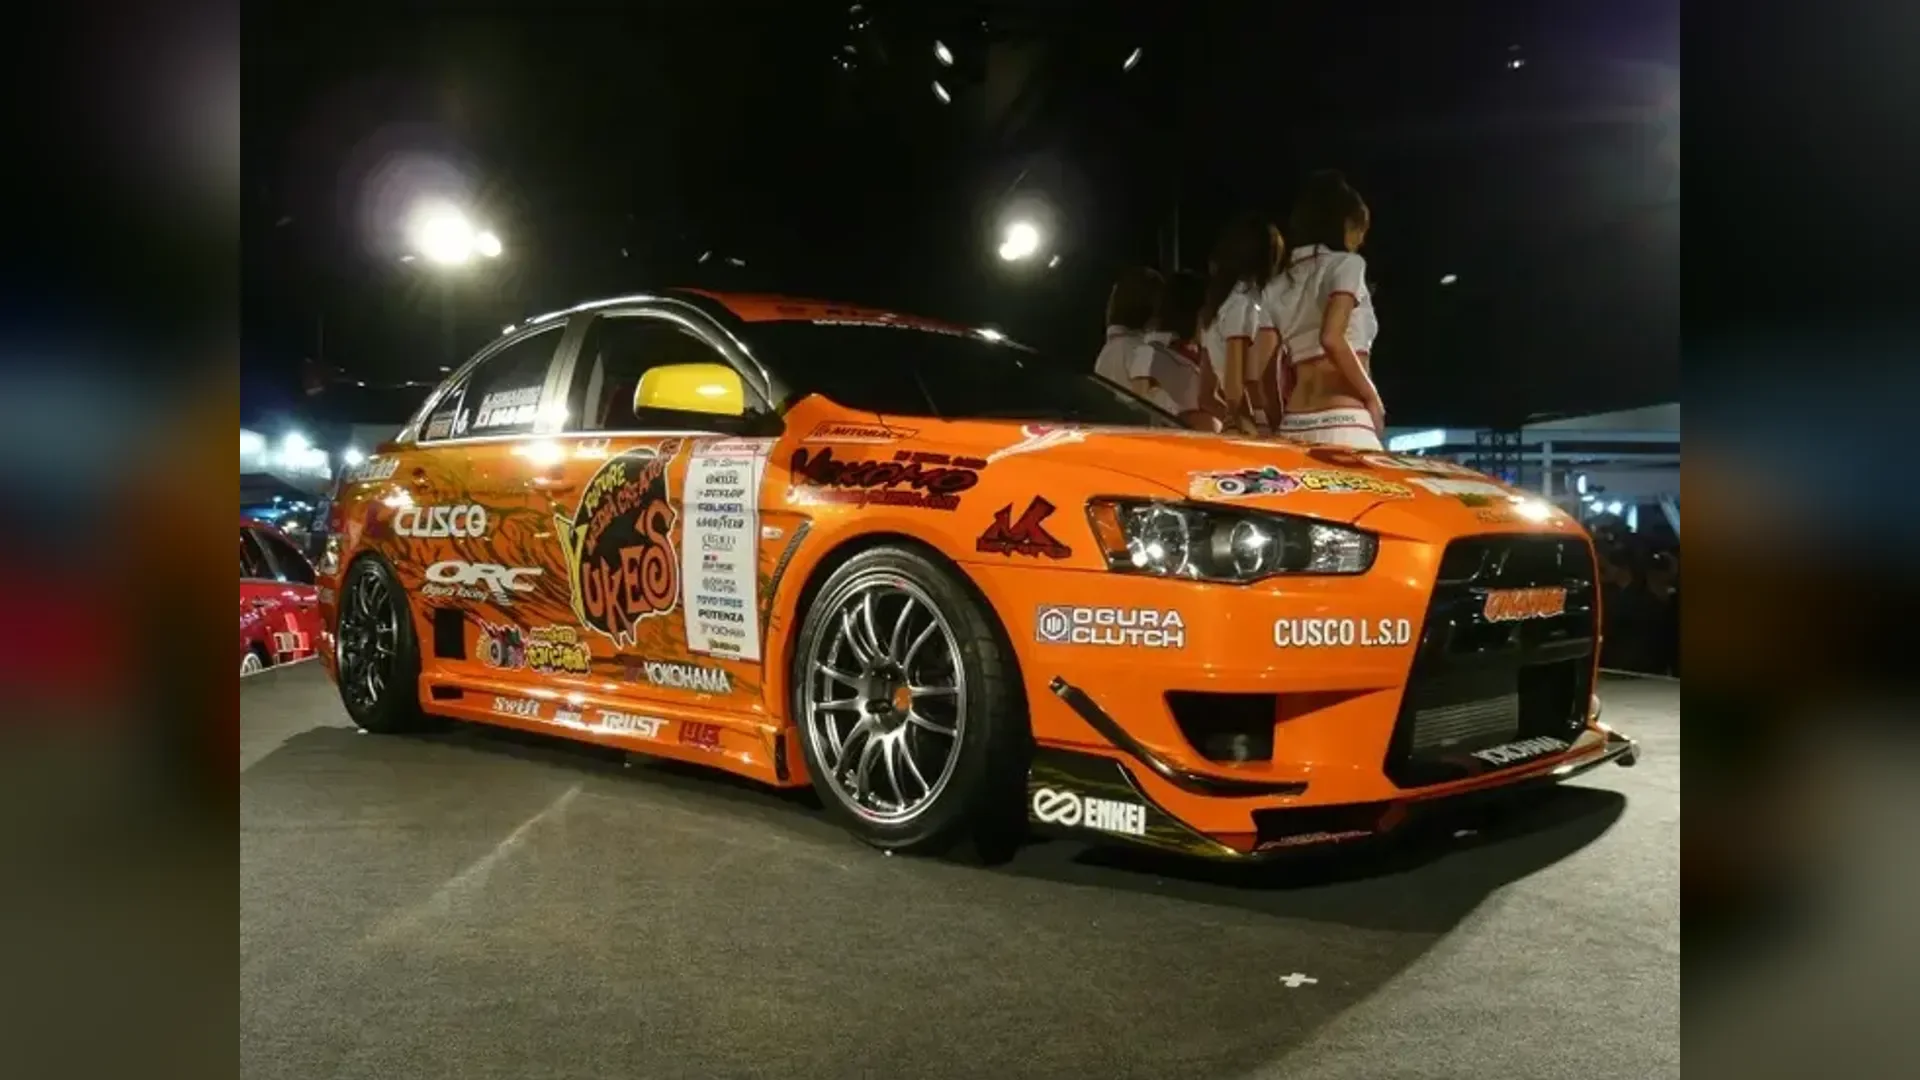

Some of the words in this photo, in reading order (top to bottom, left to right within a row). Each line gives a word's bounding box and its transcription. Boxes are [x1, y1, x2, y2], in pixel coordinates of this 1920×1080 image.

[584, 462, 627, 518] FUTURE
[394, 504, 487, 538] CUSCO
[698, 502, 744, 513] FALKEN
[696, 515, 744, 529] GOODYEAR
[425, 560, 545, 593] ORC
[698, 608, 745, 623] POTENZA
[1073, 608, 1184, 627] OGURA
[1071, 626, 1184, 648] CLUTCH
[1274, 619, 1353, 647] CUSCO
[1360, 618, 1411, 646] L.S.D
[643, 661, 732, 694] YOKOHAMA
[493, 696, 540, 717] Swift
[597, 710, 669, 738] TRUST
[1084, 796, 1146, 835] ENKEI
